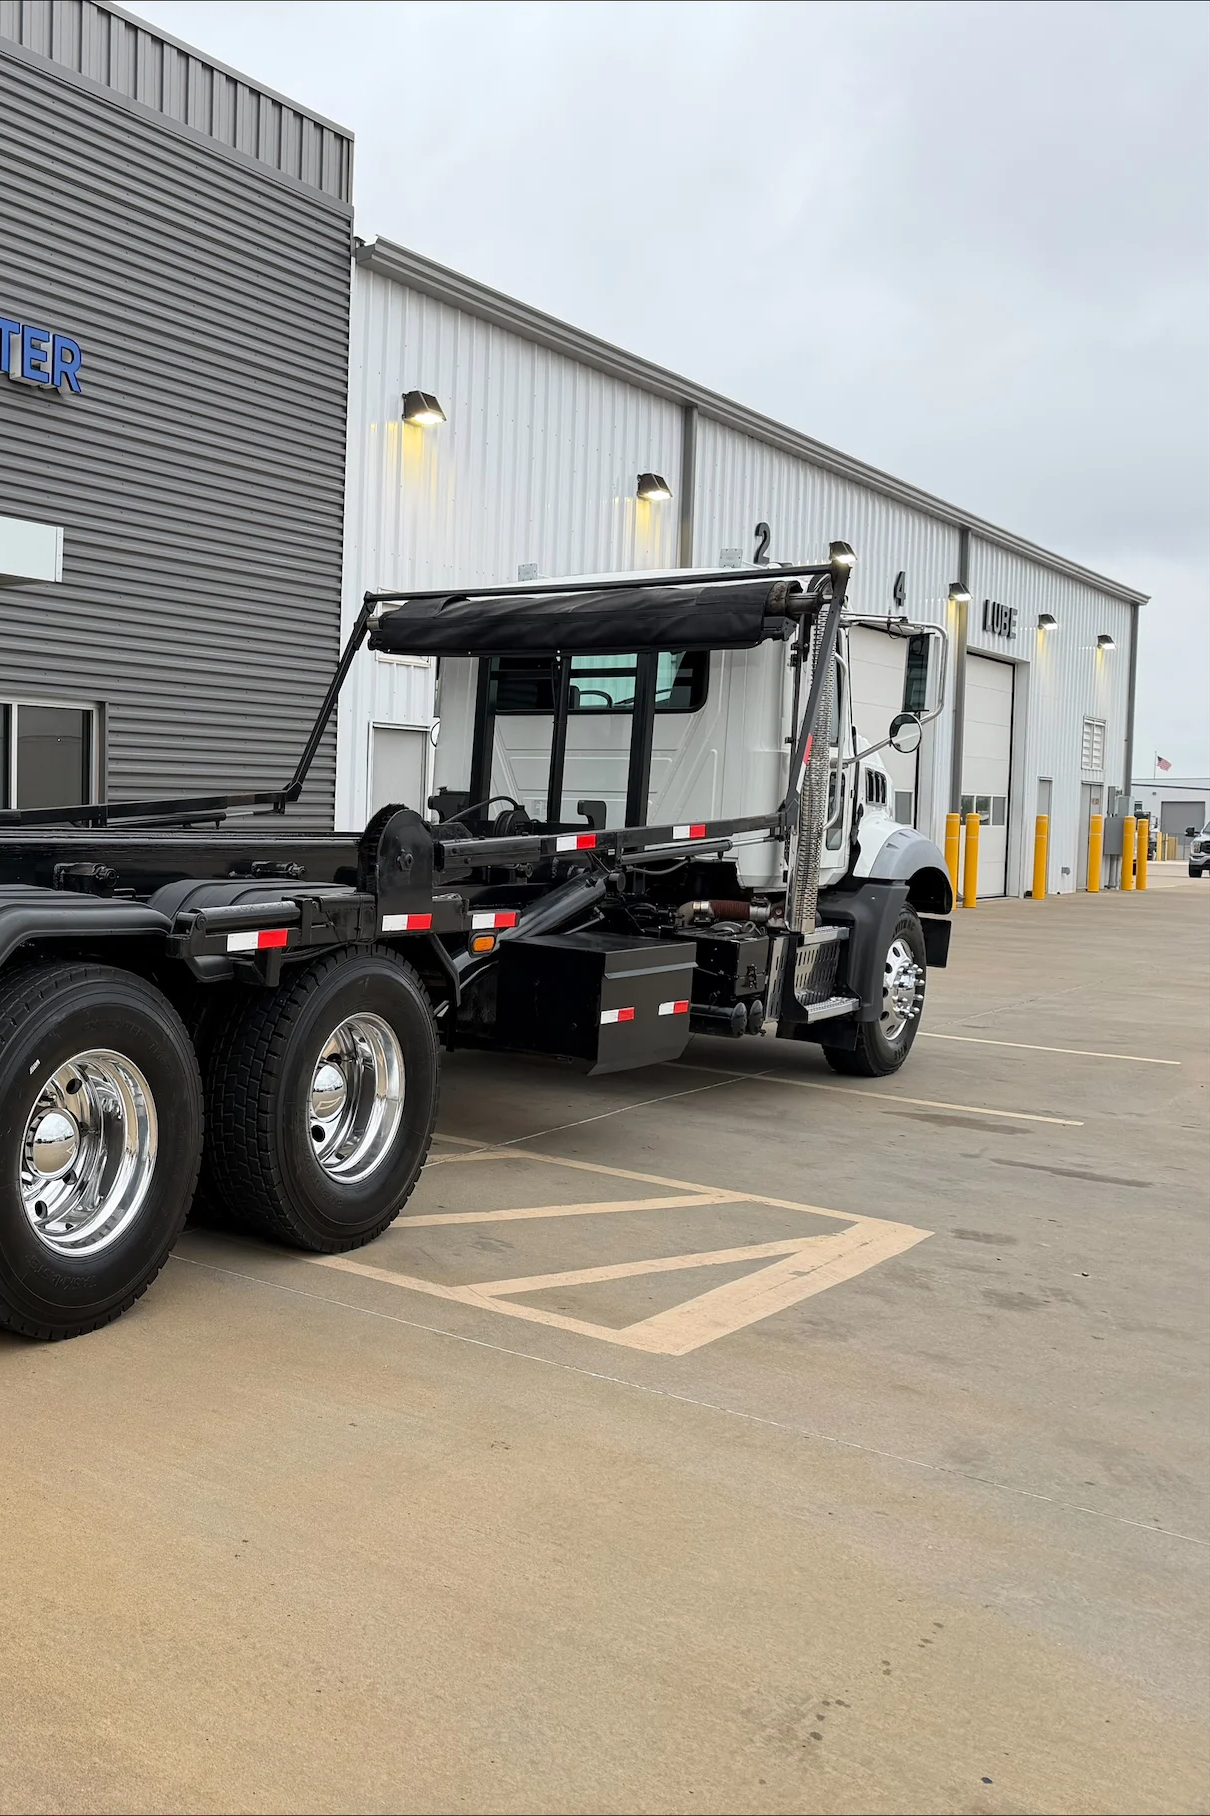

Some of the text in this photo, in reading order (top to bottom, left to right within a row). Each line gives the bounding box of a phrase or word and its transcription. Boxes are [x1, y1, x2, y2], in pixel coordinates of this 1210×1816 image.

[754, 522, 770, 564] 2
[894, 571, 906, 607] 4
[983, 599, 1018, 640] LUBE
